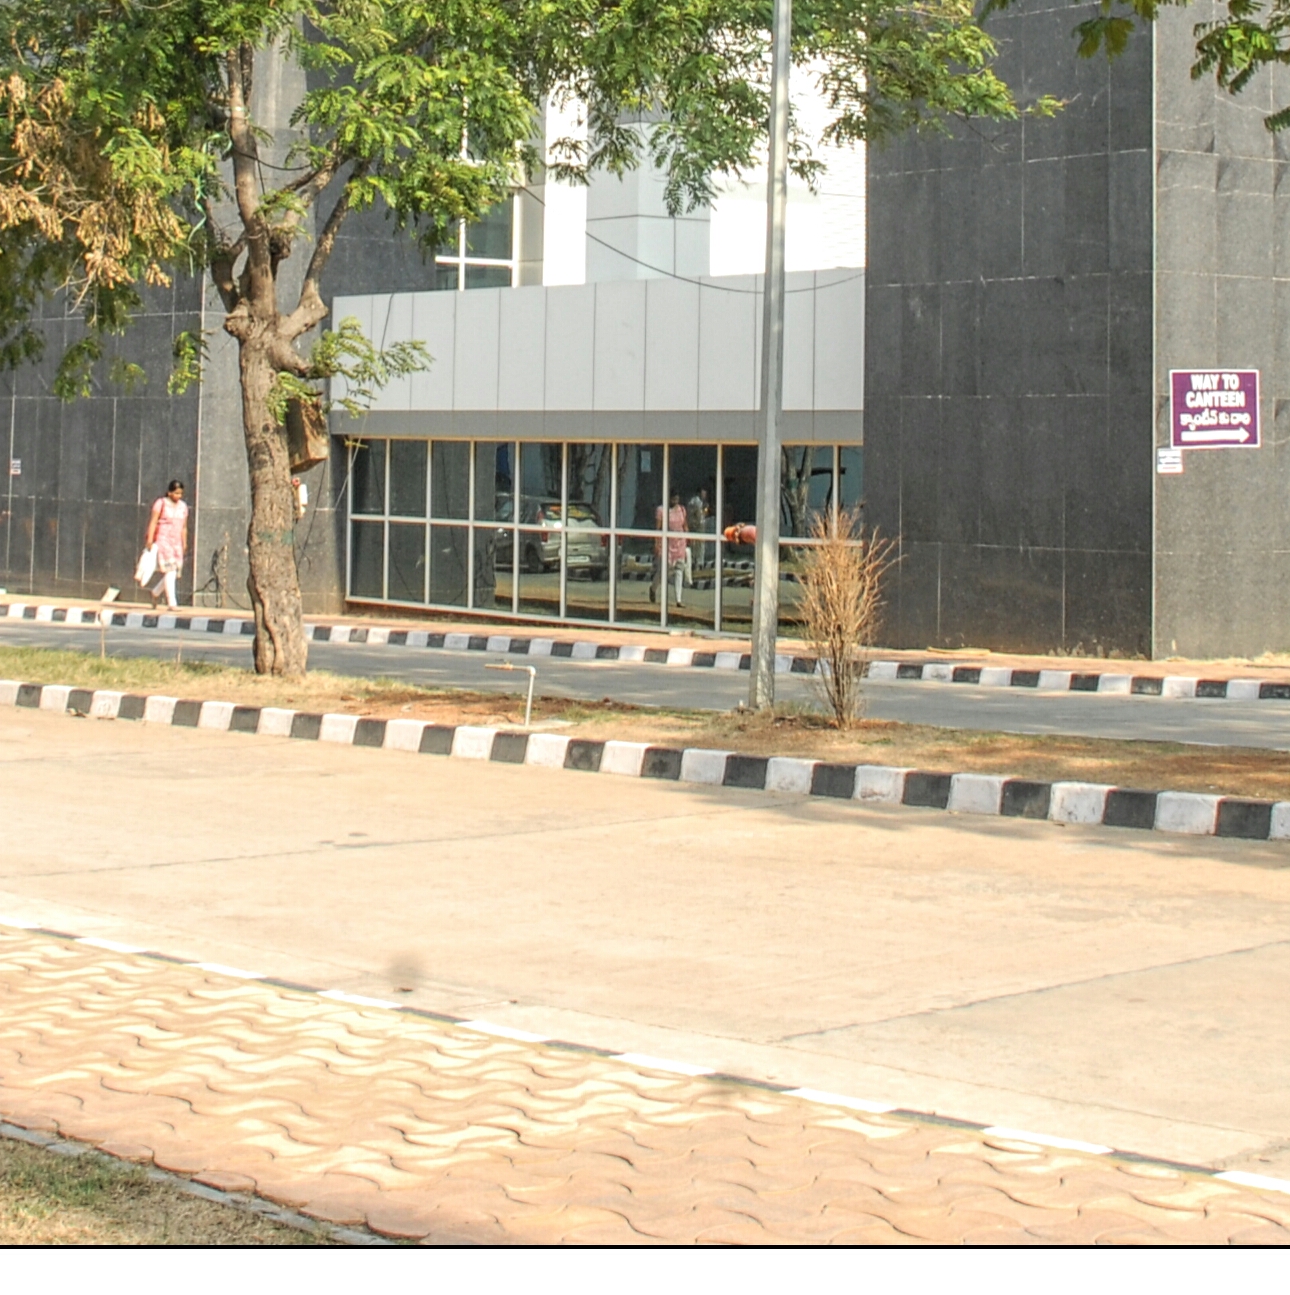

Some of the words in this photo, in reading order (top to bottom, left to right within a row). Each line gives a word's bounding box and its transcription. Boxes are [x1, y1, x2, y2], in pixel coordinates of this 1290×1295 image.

[1190, 374, 1220, 391] WAY
[1222, 374, 1240, 390] TO
[1185, 391, 1245, 408] CANTEEN
